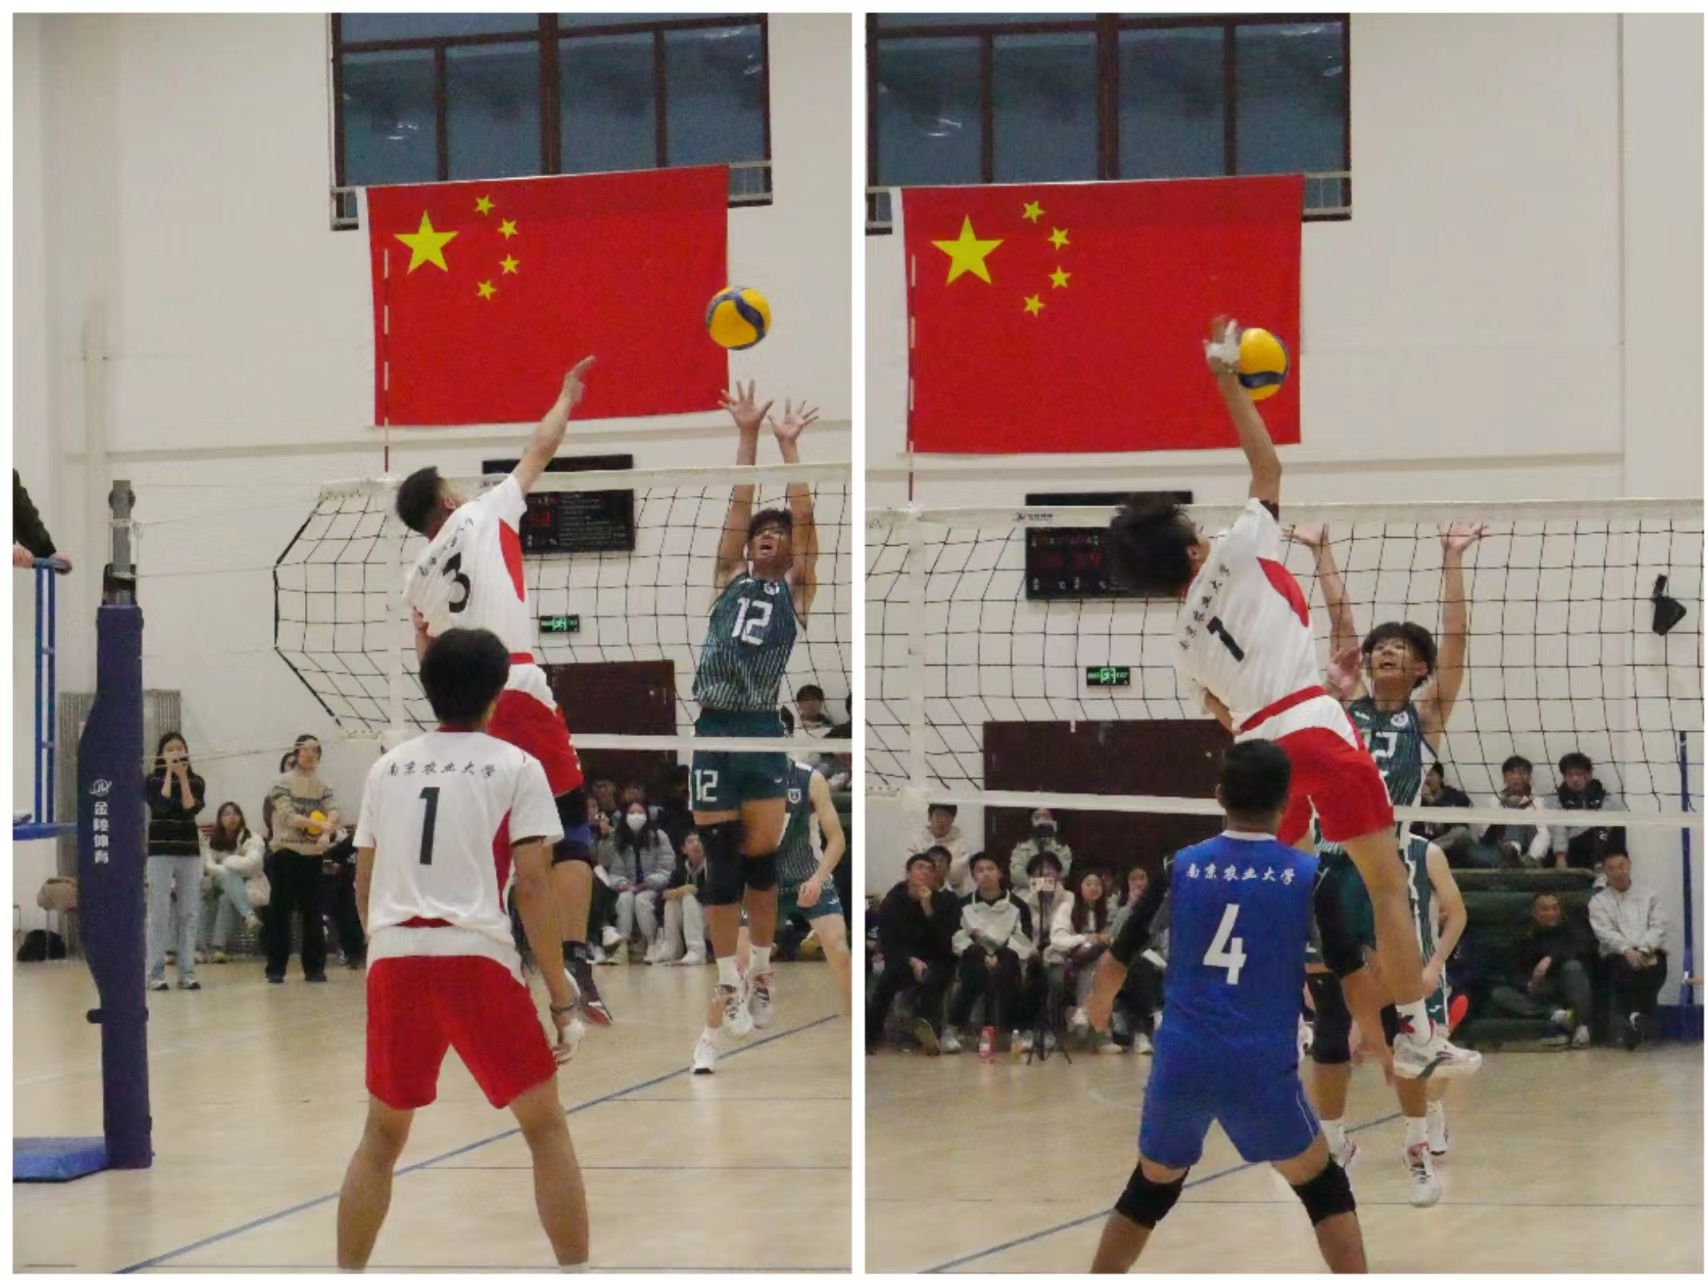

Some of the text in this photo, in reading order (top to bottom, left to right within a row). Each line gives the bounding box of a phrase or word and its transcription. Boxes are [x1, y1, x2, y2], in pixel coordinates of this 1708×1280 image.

[442, 551, 471, 614] 3
[732, 597, 773, 646] 12
[1206, 615, 1246, 662] 1
[694, 769, 719, 803] 12
[419, 786, 441, 866] 1
[1185, 862, 1296, 886] 南京农业大学
[1202, 902, 1248, 986] 4
